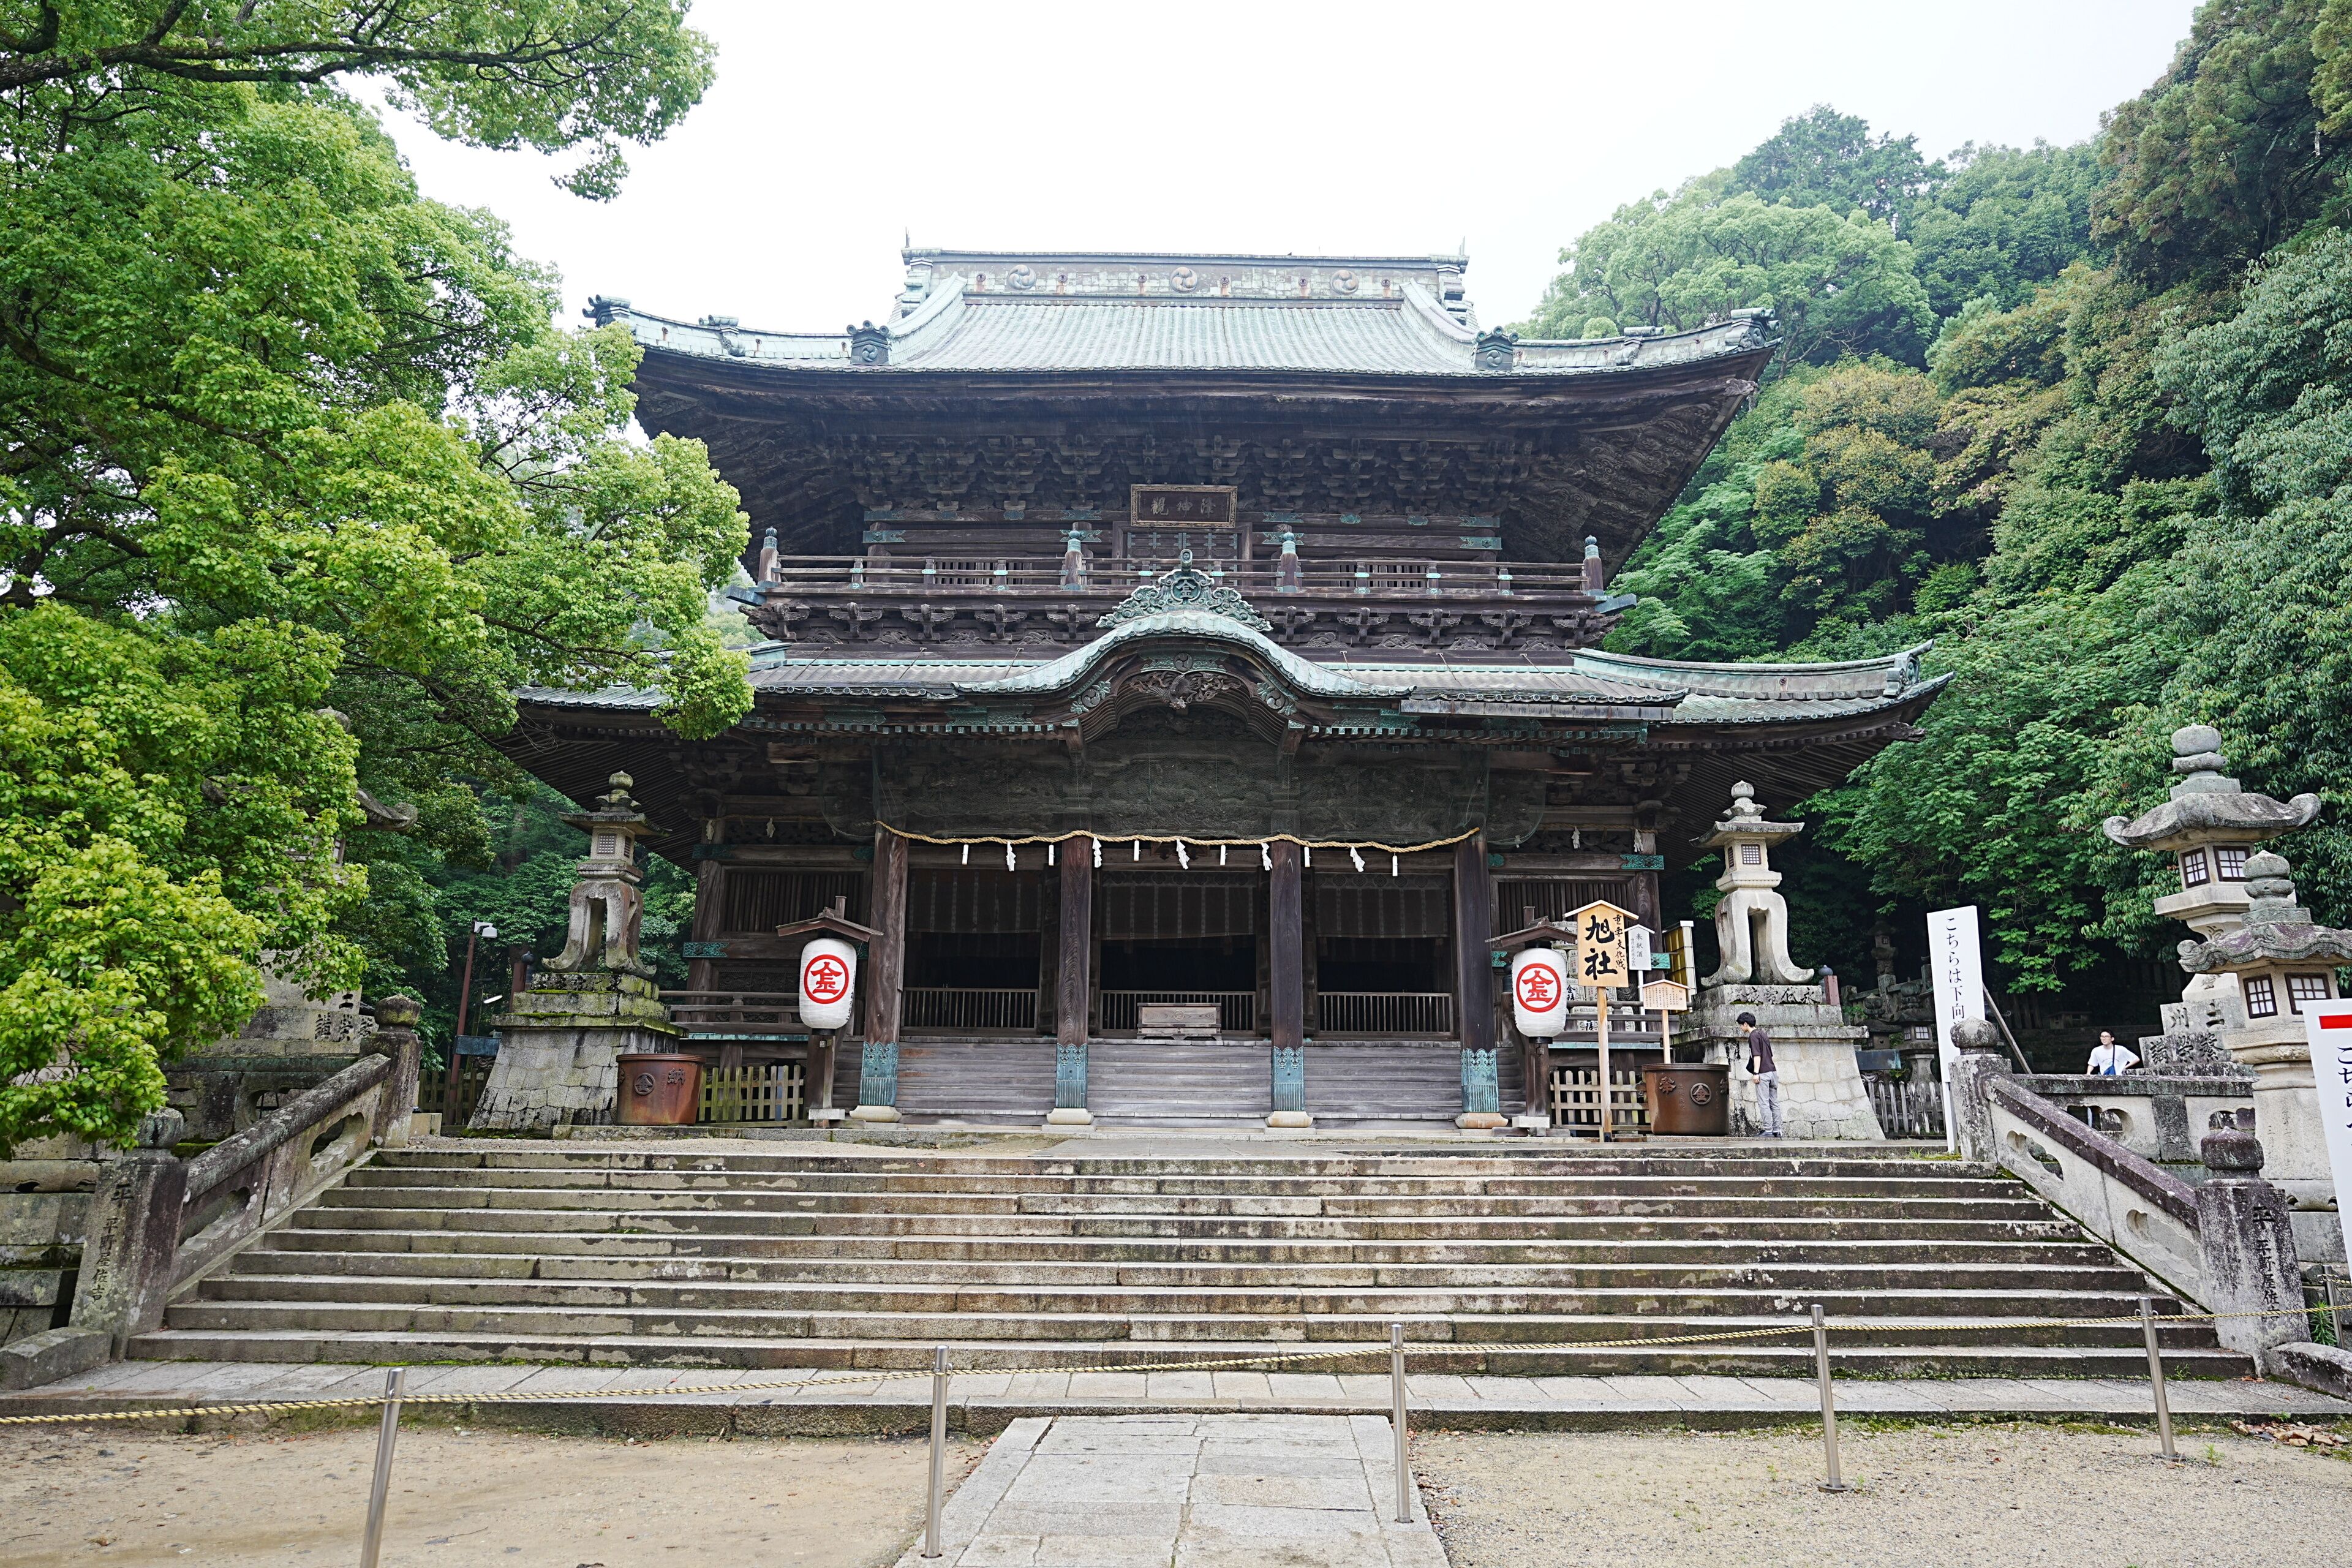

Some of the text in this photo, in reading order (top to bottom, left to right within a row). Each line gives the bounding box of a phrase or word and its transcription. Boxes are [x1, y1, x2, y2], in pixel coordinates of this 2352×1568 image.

[1176, 579, 1196, 598] 金
[1585, 914, 1618, 980] 旭社
[810, 961, 843, 995] 金
[1521, 970, 1554, 1003] 金
[1946, 918, 1965, 1025] こちらは下向
